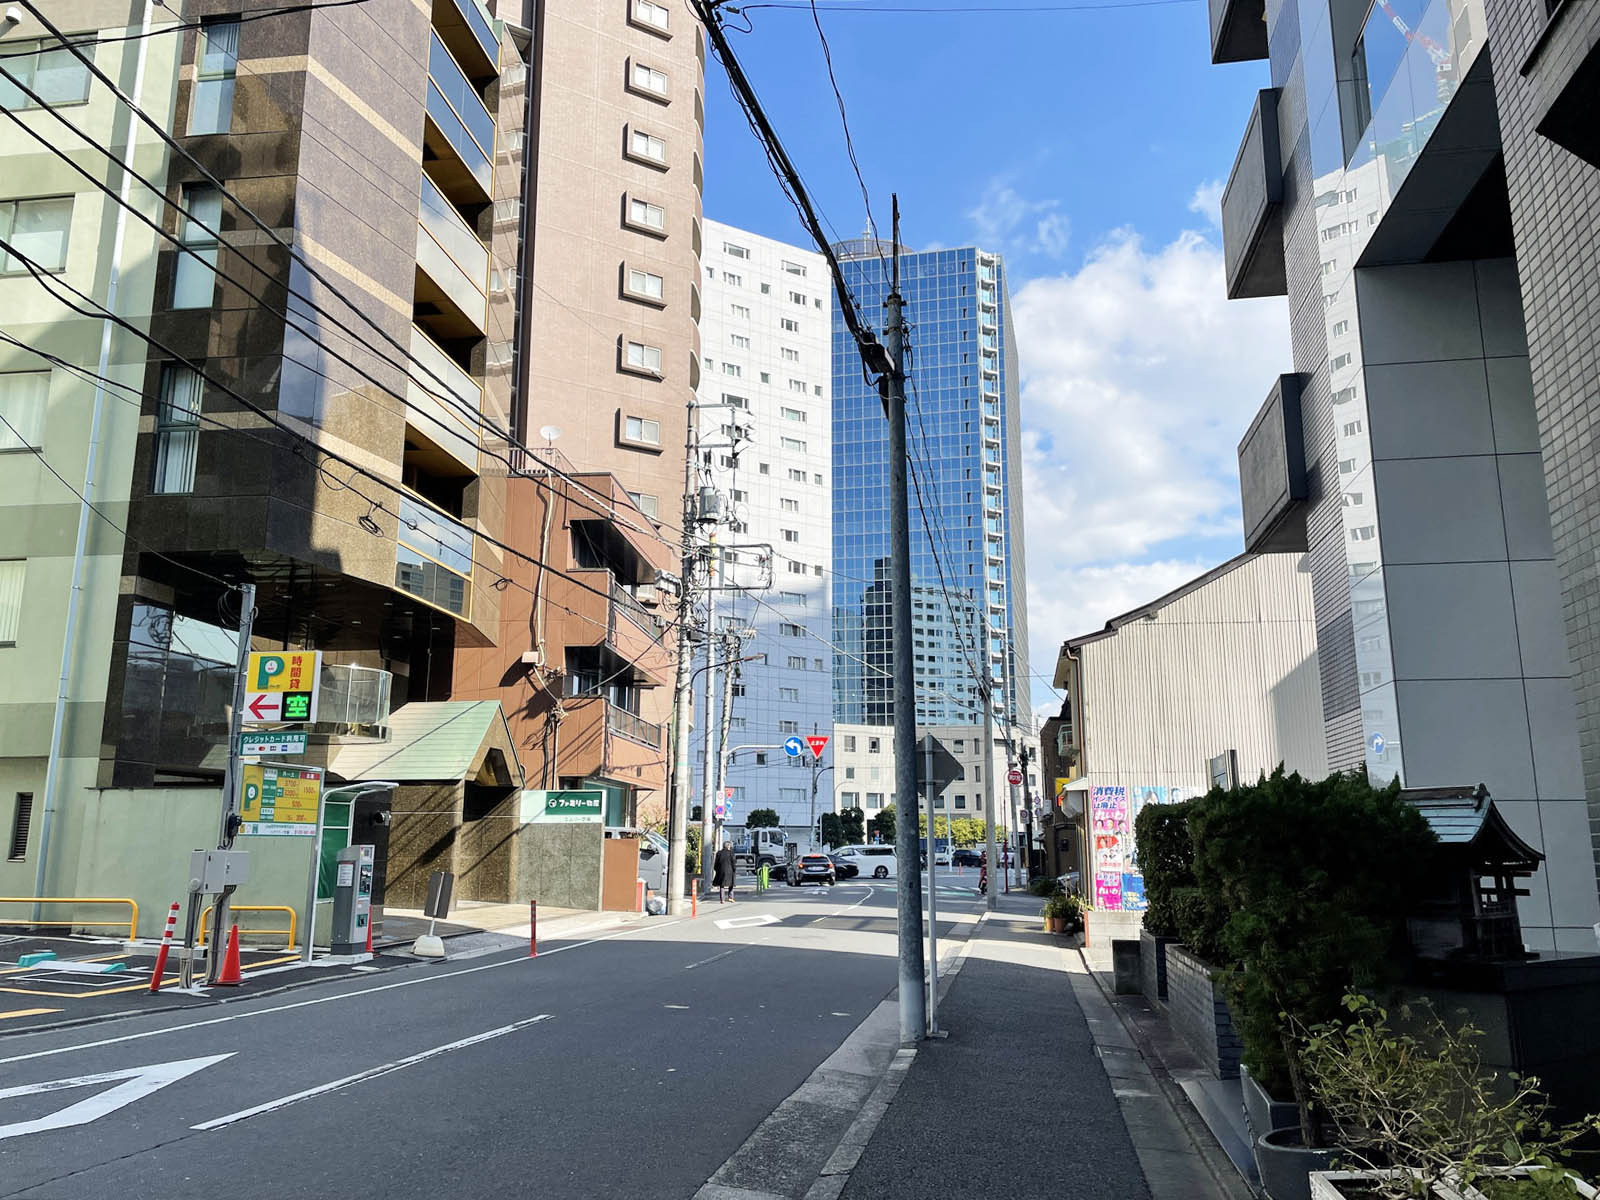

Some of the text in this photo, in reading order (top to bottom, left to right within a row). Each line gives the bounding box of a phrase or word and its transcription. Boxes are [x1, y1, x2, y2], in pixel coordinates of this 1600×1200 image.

[289, 655, 302, 689] 時間貸
[285, 695, 309, 717] 空
[243, 735, 305, 743] クレジットカード利用可
[1093, 787, 1124, 795] 消費税
